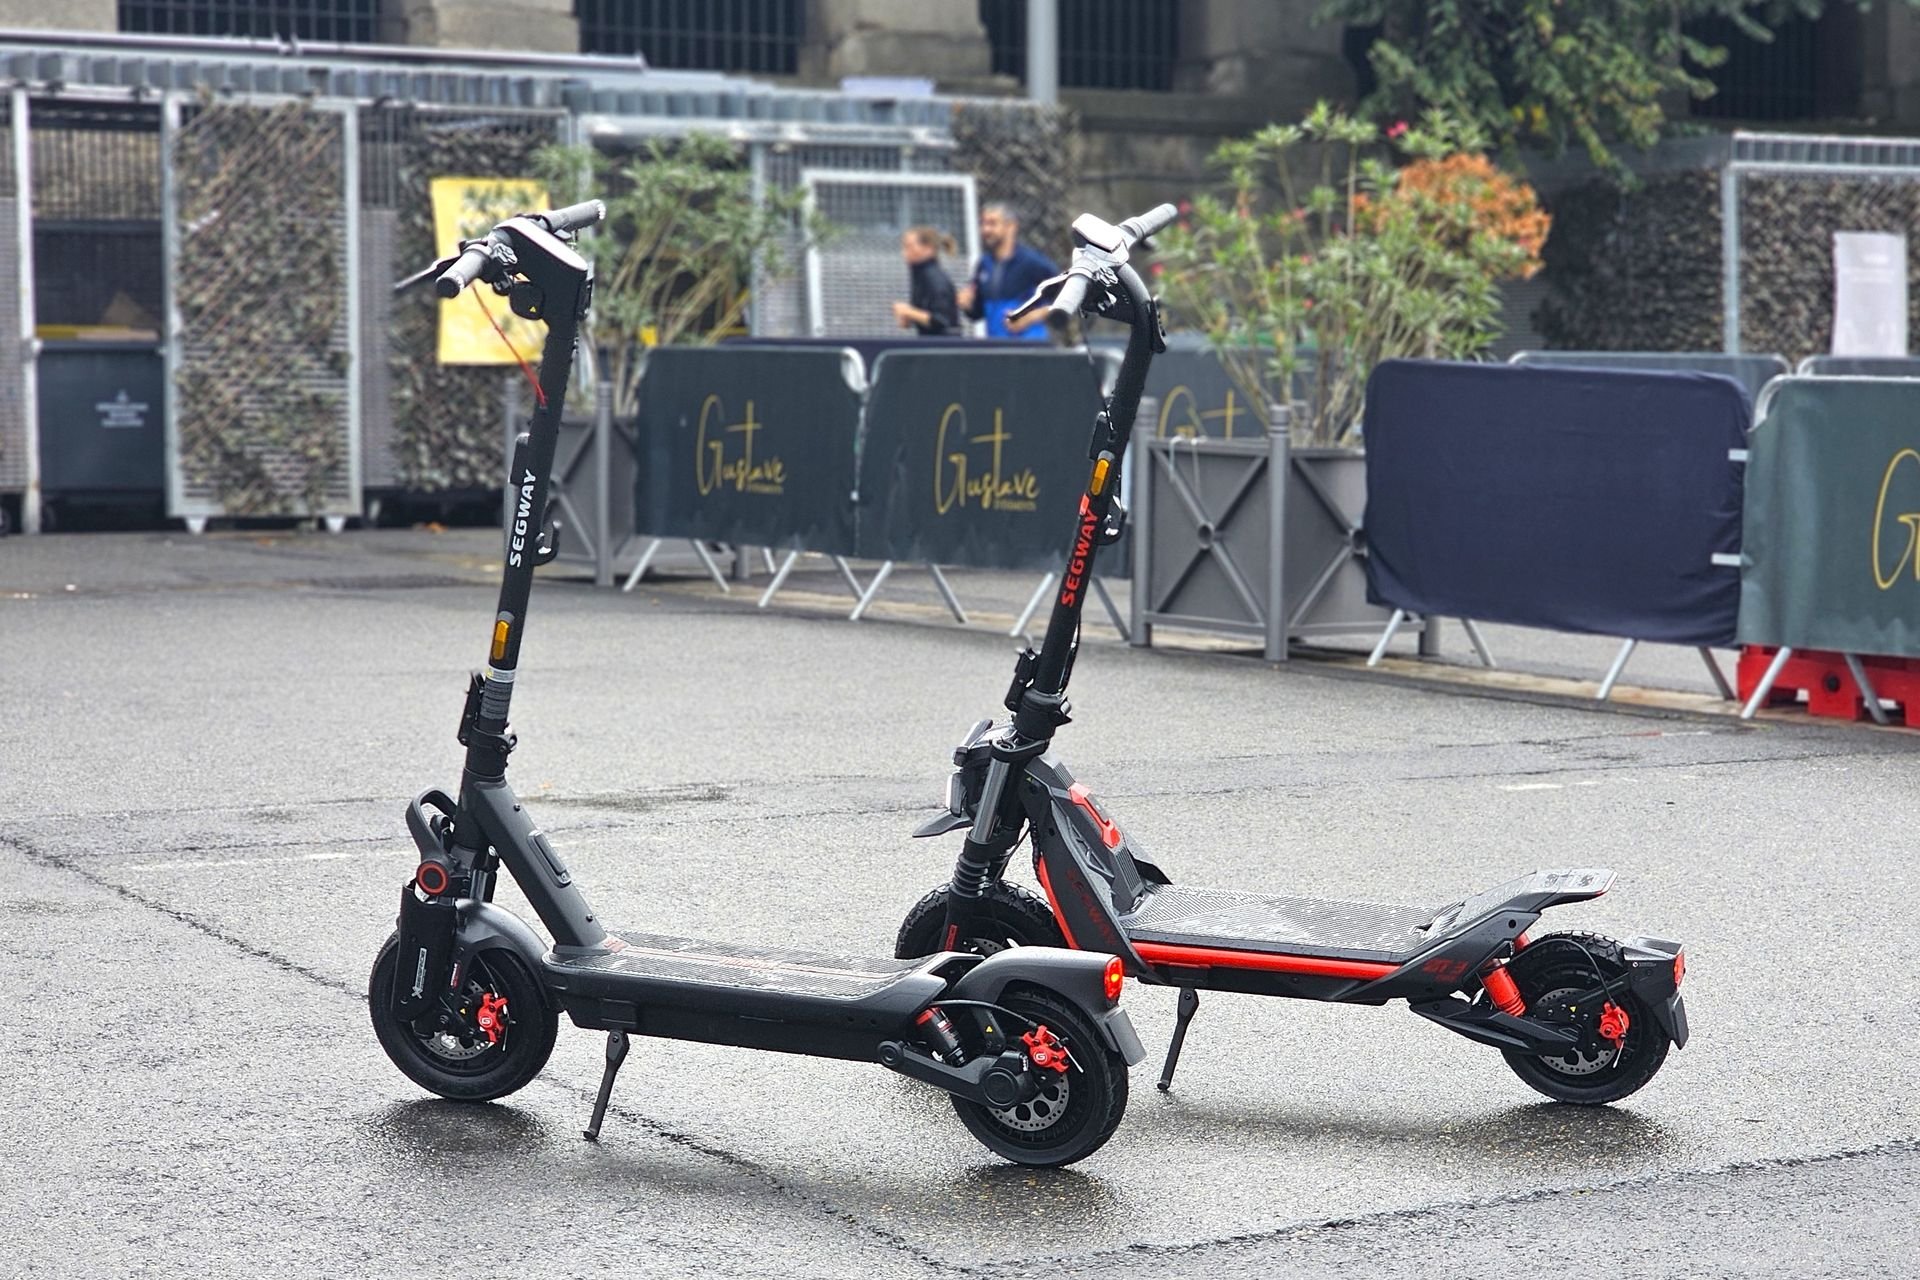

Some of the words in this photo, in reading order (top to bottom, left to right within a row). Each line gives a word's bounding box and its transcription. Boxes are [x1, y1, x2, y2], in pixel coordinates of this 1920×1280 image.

[934, 402, 1041, 515] Gustave
[509, 468, 536, 568] SEGWAY
[1061, 508, 1098, 608] SEGWAY
